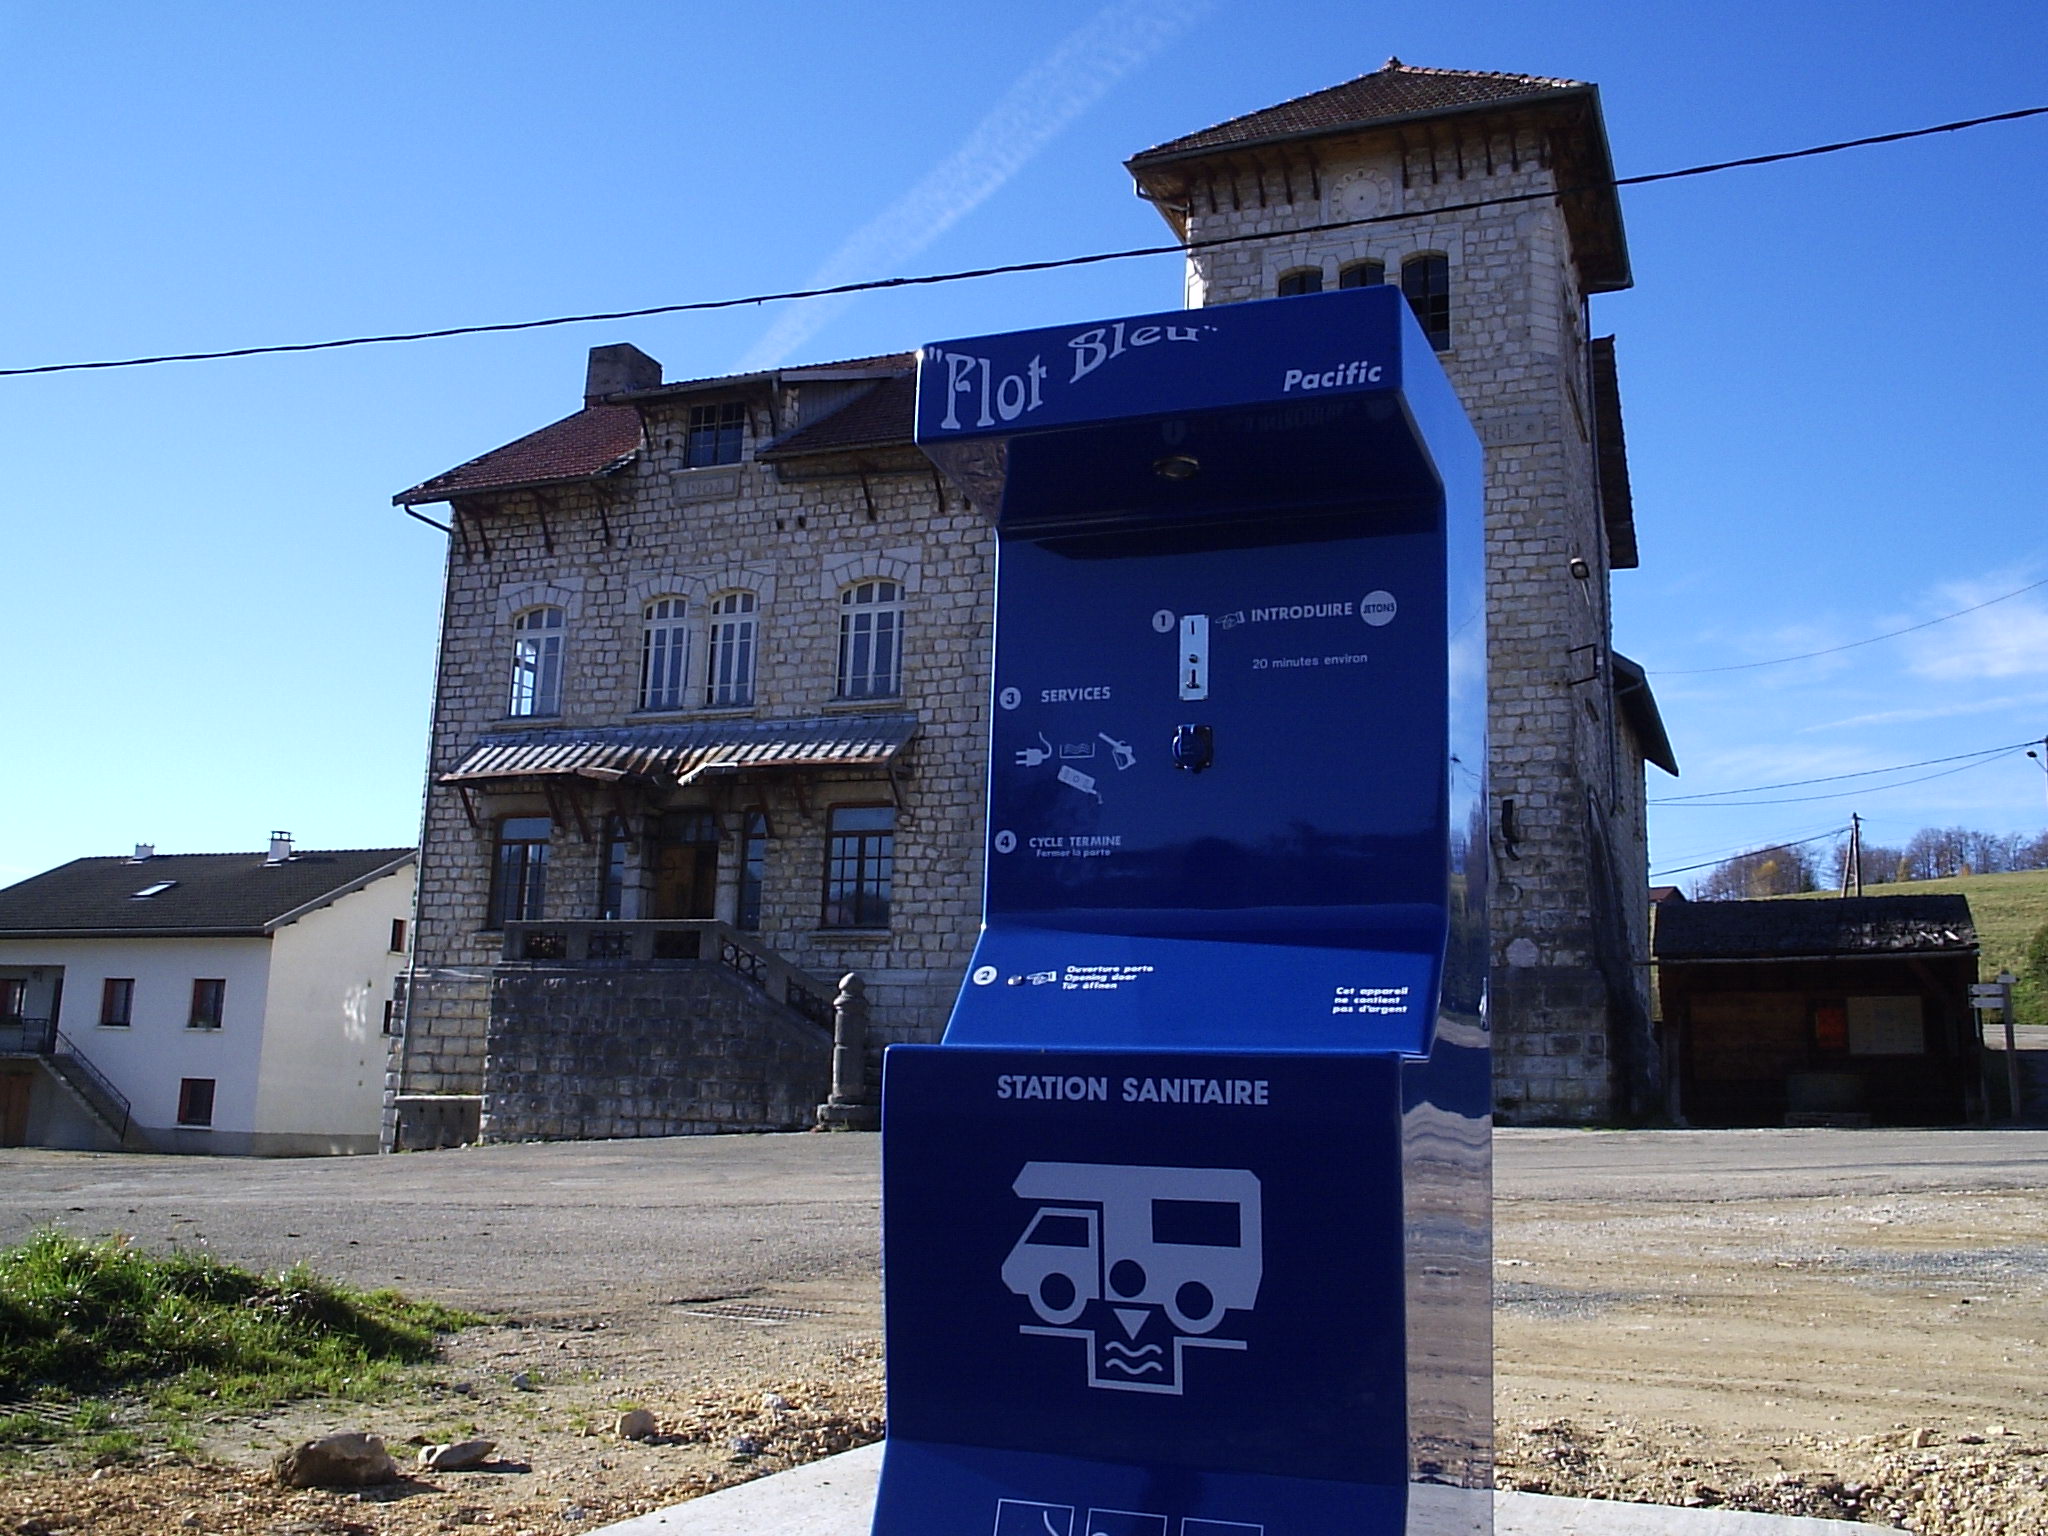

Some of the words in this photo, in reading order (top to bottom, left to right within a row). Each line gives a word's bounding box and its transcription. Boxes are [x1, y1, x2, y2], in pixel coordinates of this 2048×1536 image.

[1283, 361, 1382, 392] Pacific
[1251, 601, 1353, 622] INTRODUIRE
[1363, 602, 1396, 615] JETONS
[1252, 658, 1269, 670] 20
[1271, 656, 1319, 669] minutes
[1323, 653, 1368, 665] environ
[1005, 692, 1016, 705] 3
[1041, 686, 1111, 703] SERVICES
[1000, 835, 1011, 849] 4
[1028, 836, 1064, 848] CYCLE
[1069, 835, 1121, 847] TERMINE
[1072, 847, 1082, 857] la
[1066, 965, 1121, 974] Ouverture
[1123, 964, 1155, 974] porte
[1063, 973, 1108, 983] Opening
[1111, 972, 1138, 982] door
[1335, 986, 1355, 996] Cet
[1359, 986, 1409, 997] appareil
[1333, 997, 1349, 1005] ne
[1353, 995, 1401, 1005] contient
[1332, 1006, 1354, 1015] pas
[1358, 1005, 1408, 1016] d'argent
[996, 1074, 1108, 1101] STATION
[1122, 1077, 1269, 1105] SANITAIRE
